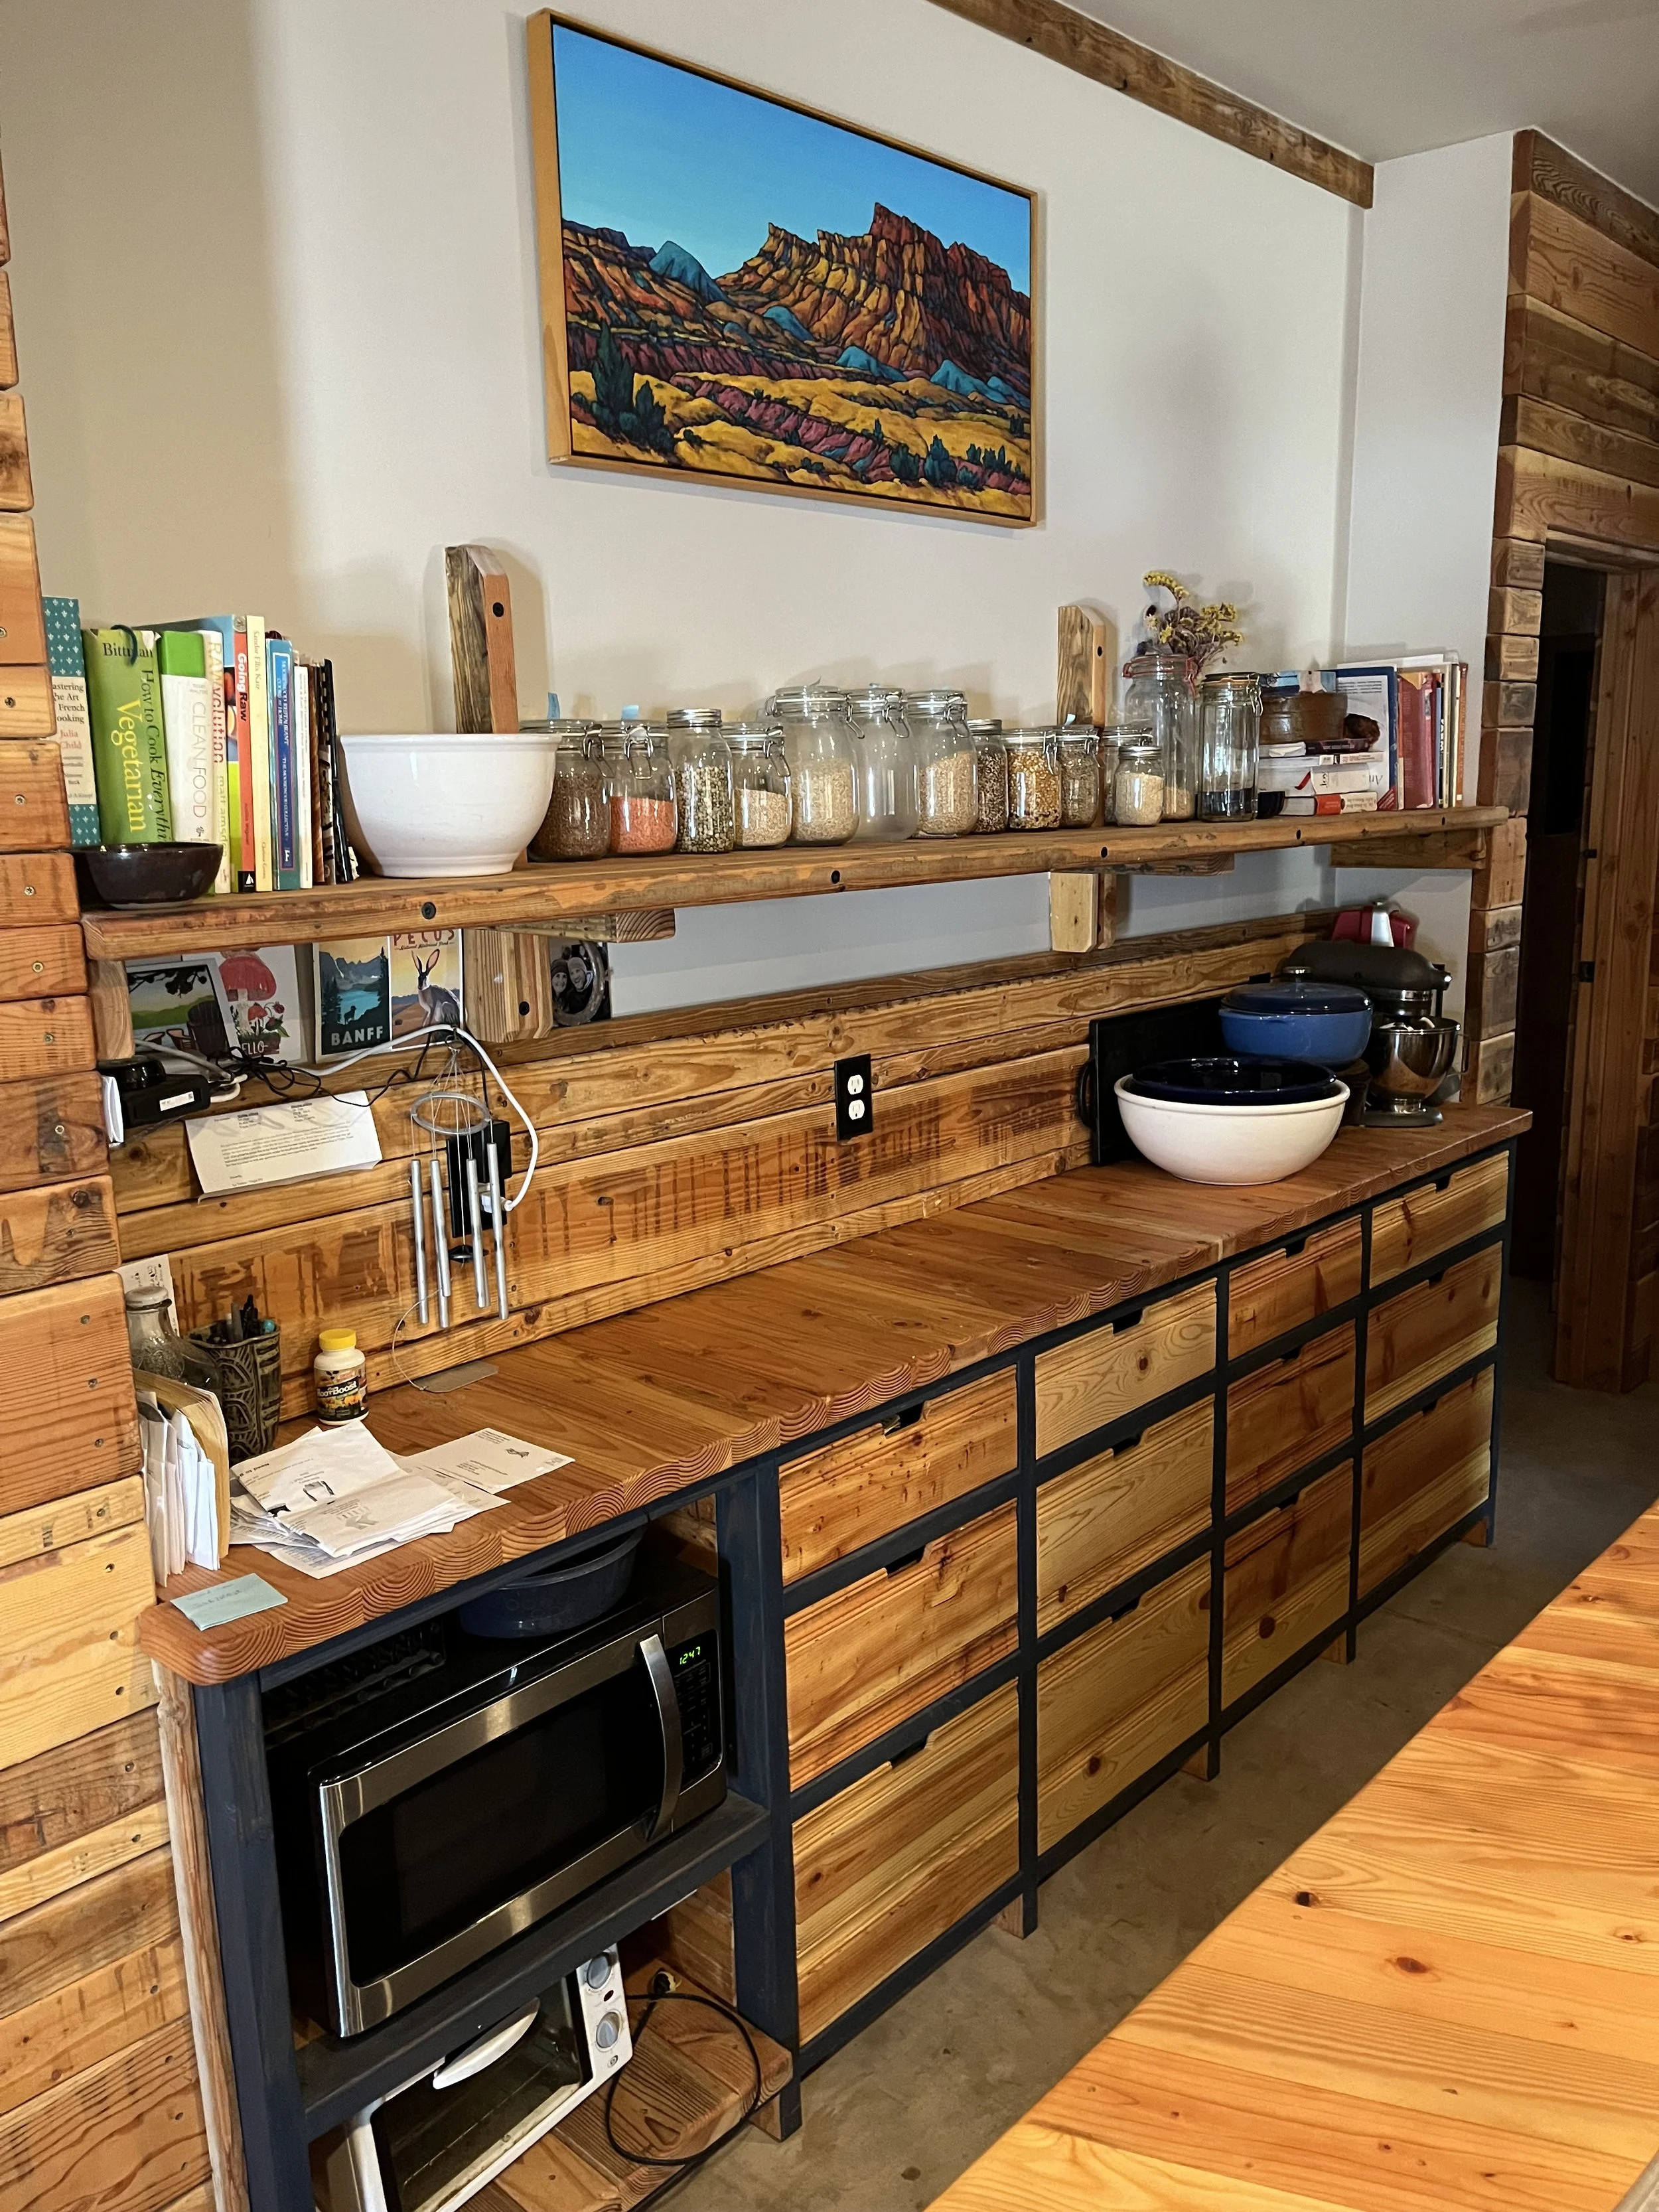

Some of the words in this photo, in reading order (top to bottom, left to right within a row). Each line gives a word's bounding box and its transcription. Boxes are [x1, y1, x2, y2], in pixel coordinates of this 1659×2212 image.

[102, 642, 153, 658] Bittan
[52, 683, 84, 692] astering
[141, 670, 155, 702] How
[58, 703, 85, 712] French
[144, 707, 154, 722] to
[56, 714, 84, 724] ooking
[60, 730, 78, 740] Julia
[192, 701, 206, 757] CLEAN
[60, 739, 82, 749] Child
[147, 725, 163, 764] Cook
[111, 699, 147, 833] Vegetarian
[193, 767, 207, 818] FOOD
[150, 767, 171, 842] Everythi
[332, 1026, 384, 1046] BANFF
[242, 1041, 268, 1055] ELLO
